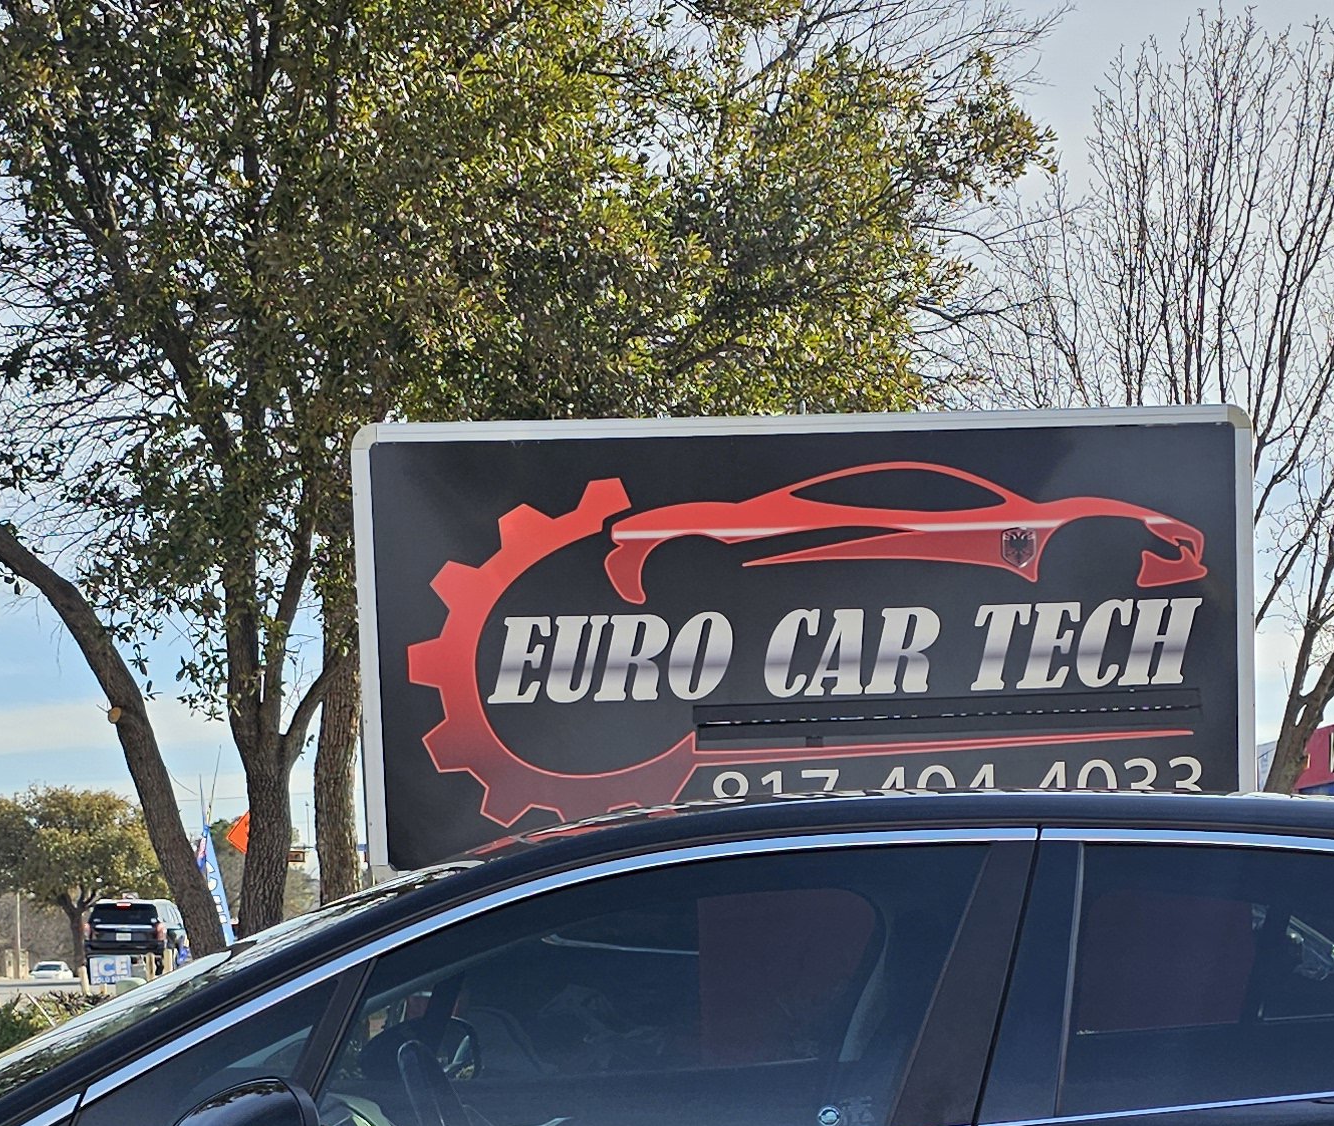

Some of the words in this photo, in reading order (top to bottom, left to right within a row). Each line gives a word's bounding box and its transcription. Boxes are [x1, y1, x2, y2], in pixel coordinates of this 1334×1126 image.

[487, 611, 734, 705] EURO
[762, 605, 942, 697] CAR
[970, 597, 1203, 692] TECH
[92, 956, 128, 976] ICE
